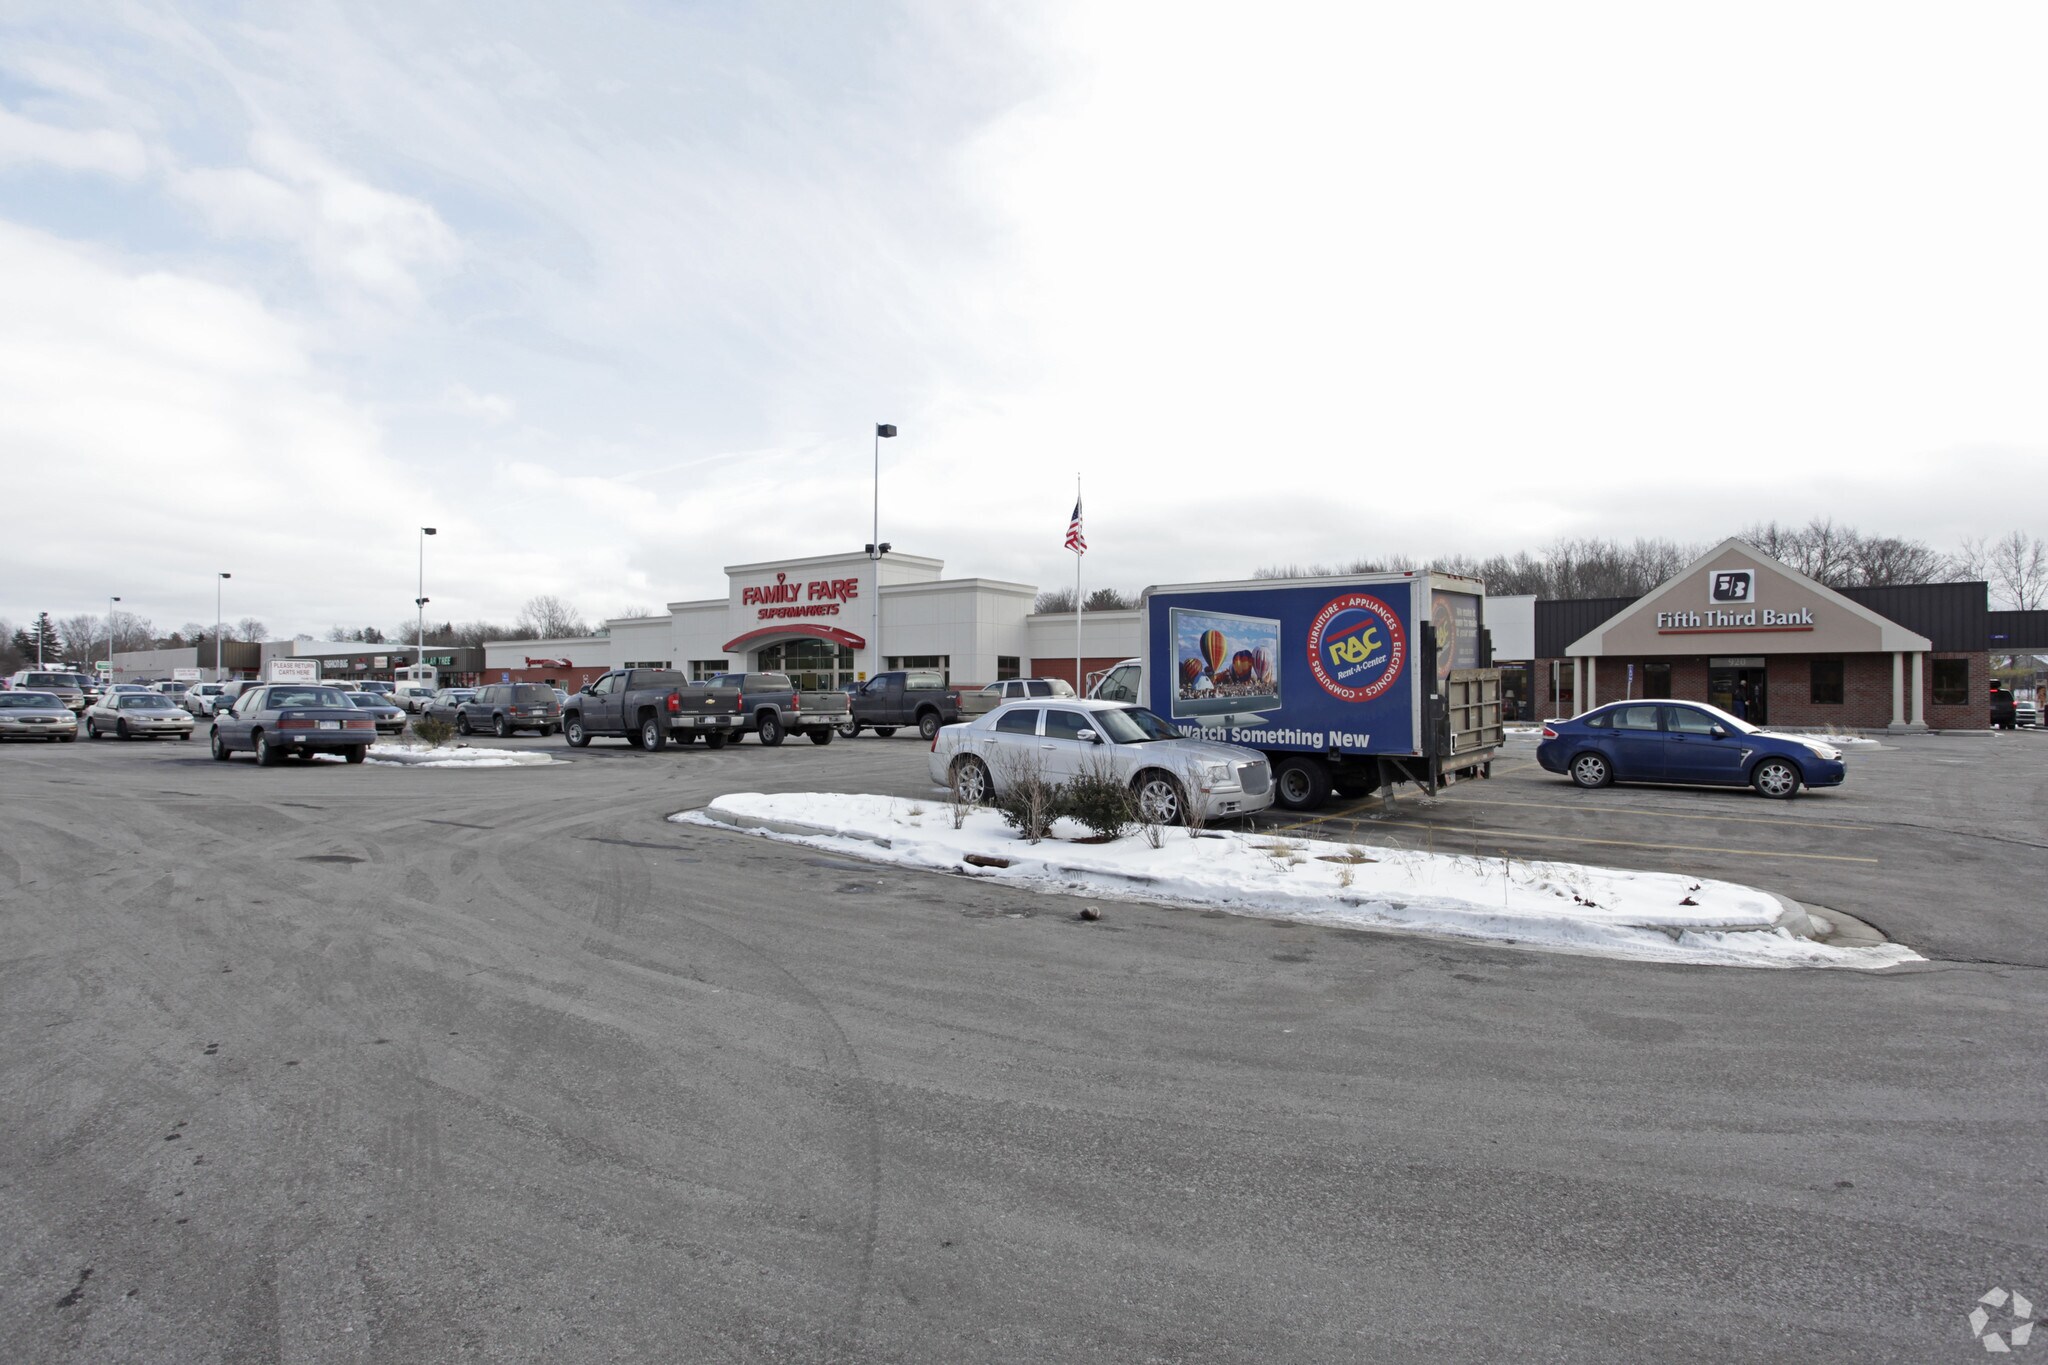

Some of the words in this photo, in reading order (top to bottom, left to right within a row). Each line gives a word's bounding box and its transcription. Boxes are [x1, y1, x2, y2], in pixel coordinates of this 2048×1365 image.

[742, 573, 802, 605] FAMILY
[807, 578, 859, 603] FARE
[757, 603, 840, 620] SUPERMARKETS
[1309, 603, 1339, 649] FURNITURE
[1349, 597, 1397, 630] APPLIANCES
[1657, 610, 1700, 628] Fifth
[1704, 608, 1756, 627] Third
[1762, 607, 1814, 625] Bank
[438, 656, 451, 665] TREE
[1329, 627, 1382, 666] RAC
[1727, 658, 1746, 666] 920
[1312, 660, 1355, 699] COMPUTERS
[1366, 641, 1401, 697] ELECTRONICS
[1178, 724, 1227, 742] Watch
[1231, 727, 1324, 749] Something
[1329, 731, 1370, 748] New
